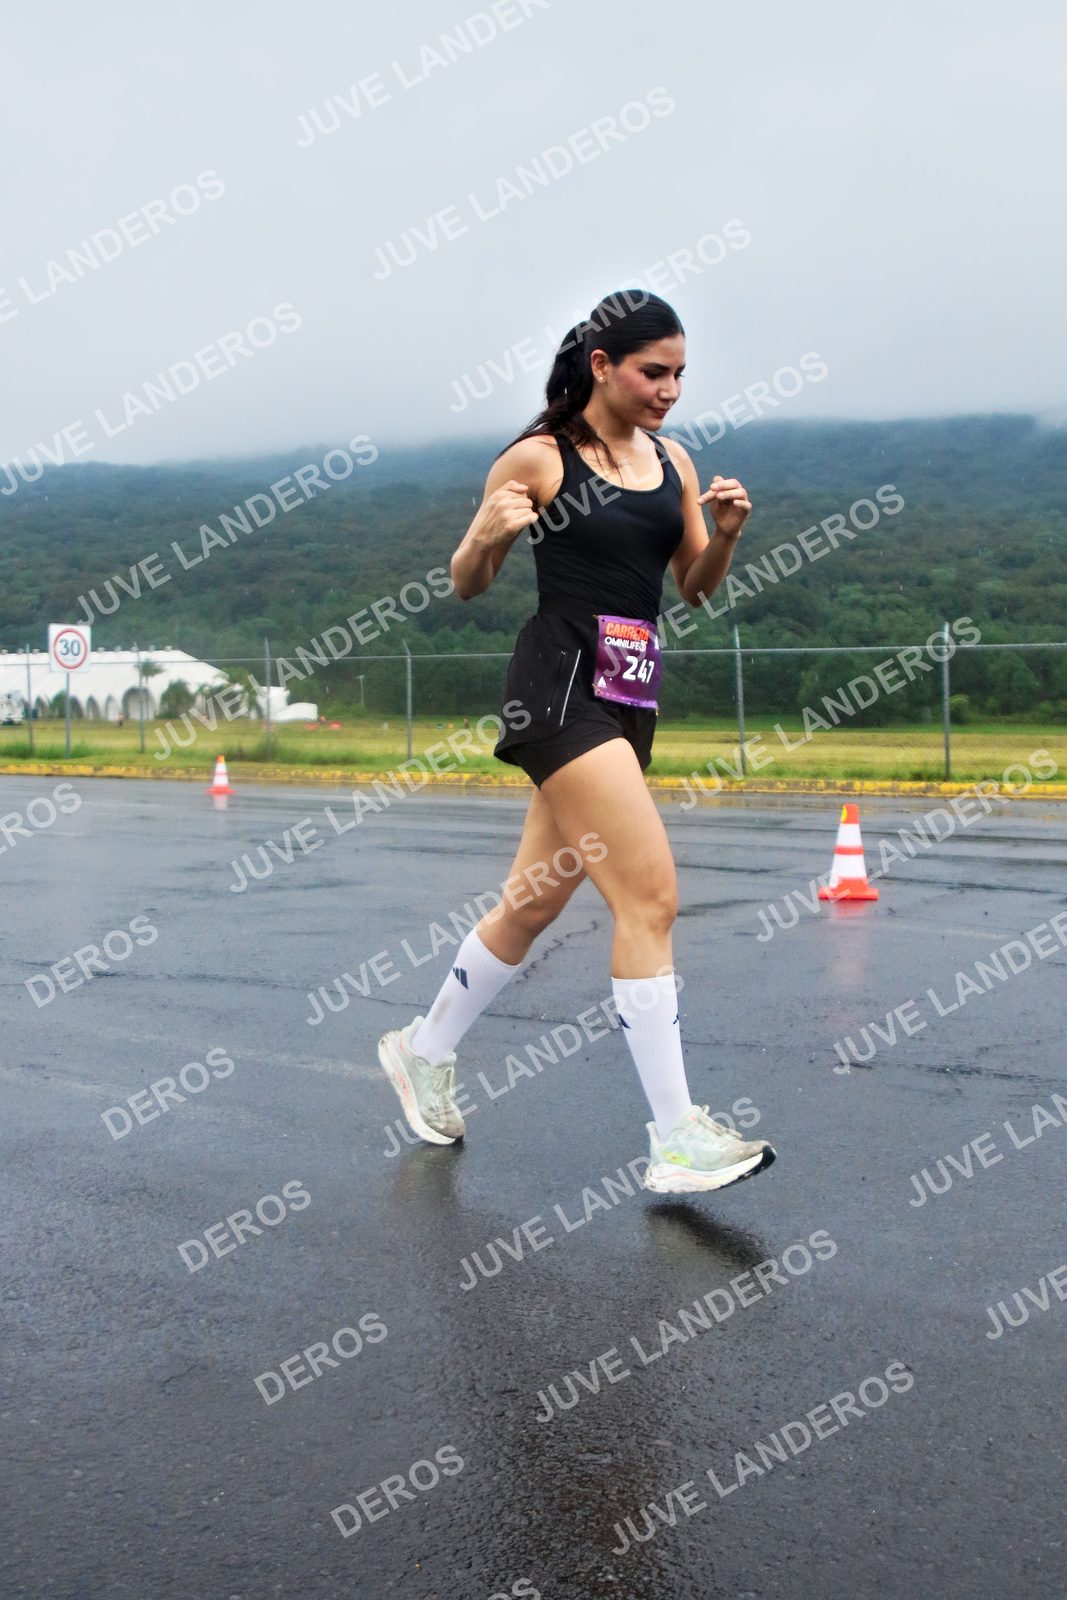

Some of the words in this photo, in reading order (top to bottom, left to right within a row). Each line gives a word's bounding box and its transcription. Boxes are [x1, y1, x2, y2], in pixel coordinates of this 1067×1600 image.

[605, 622, 649, 641] CARRERA
[59, 639, 81, 656] 30
[604, 636, 639, 651] OMNILIFE
[622, 656, 655, 684] 247
